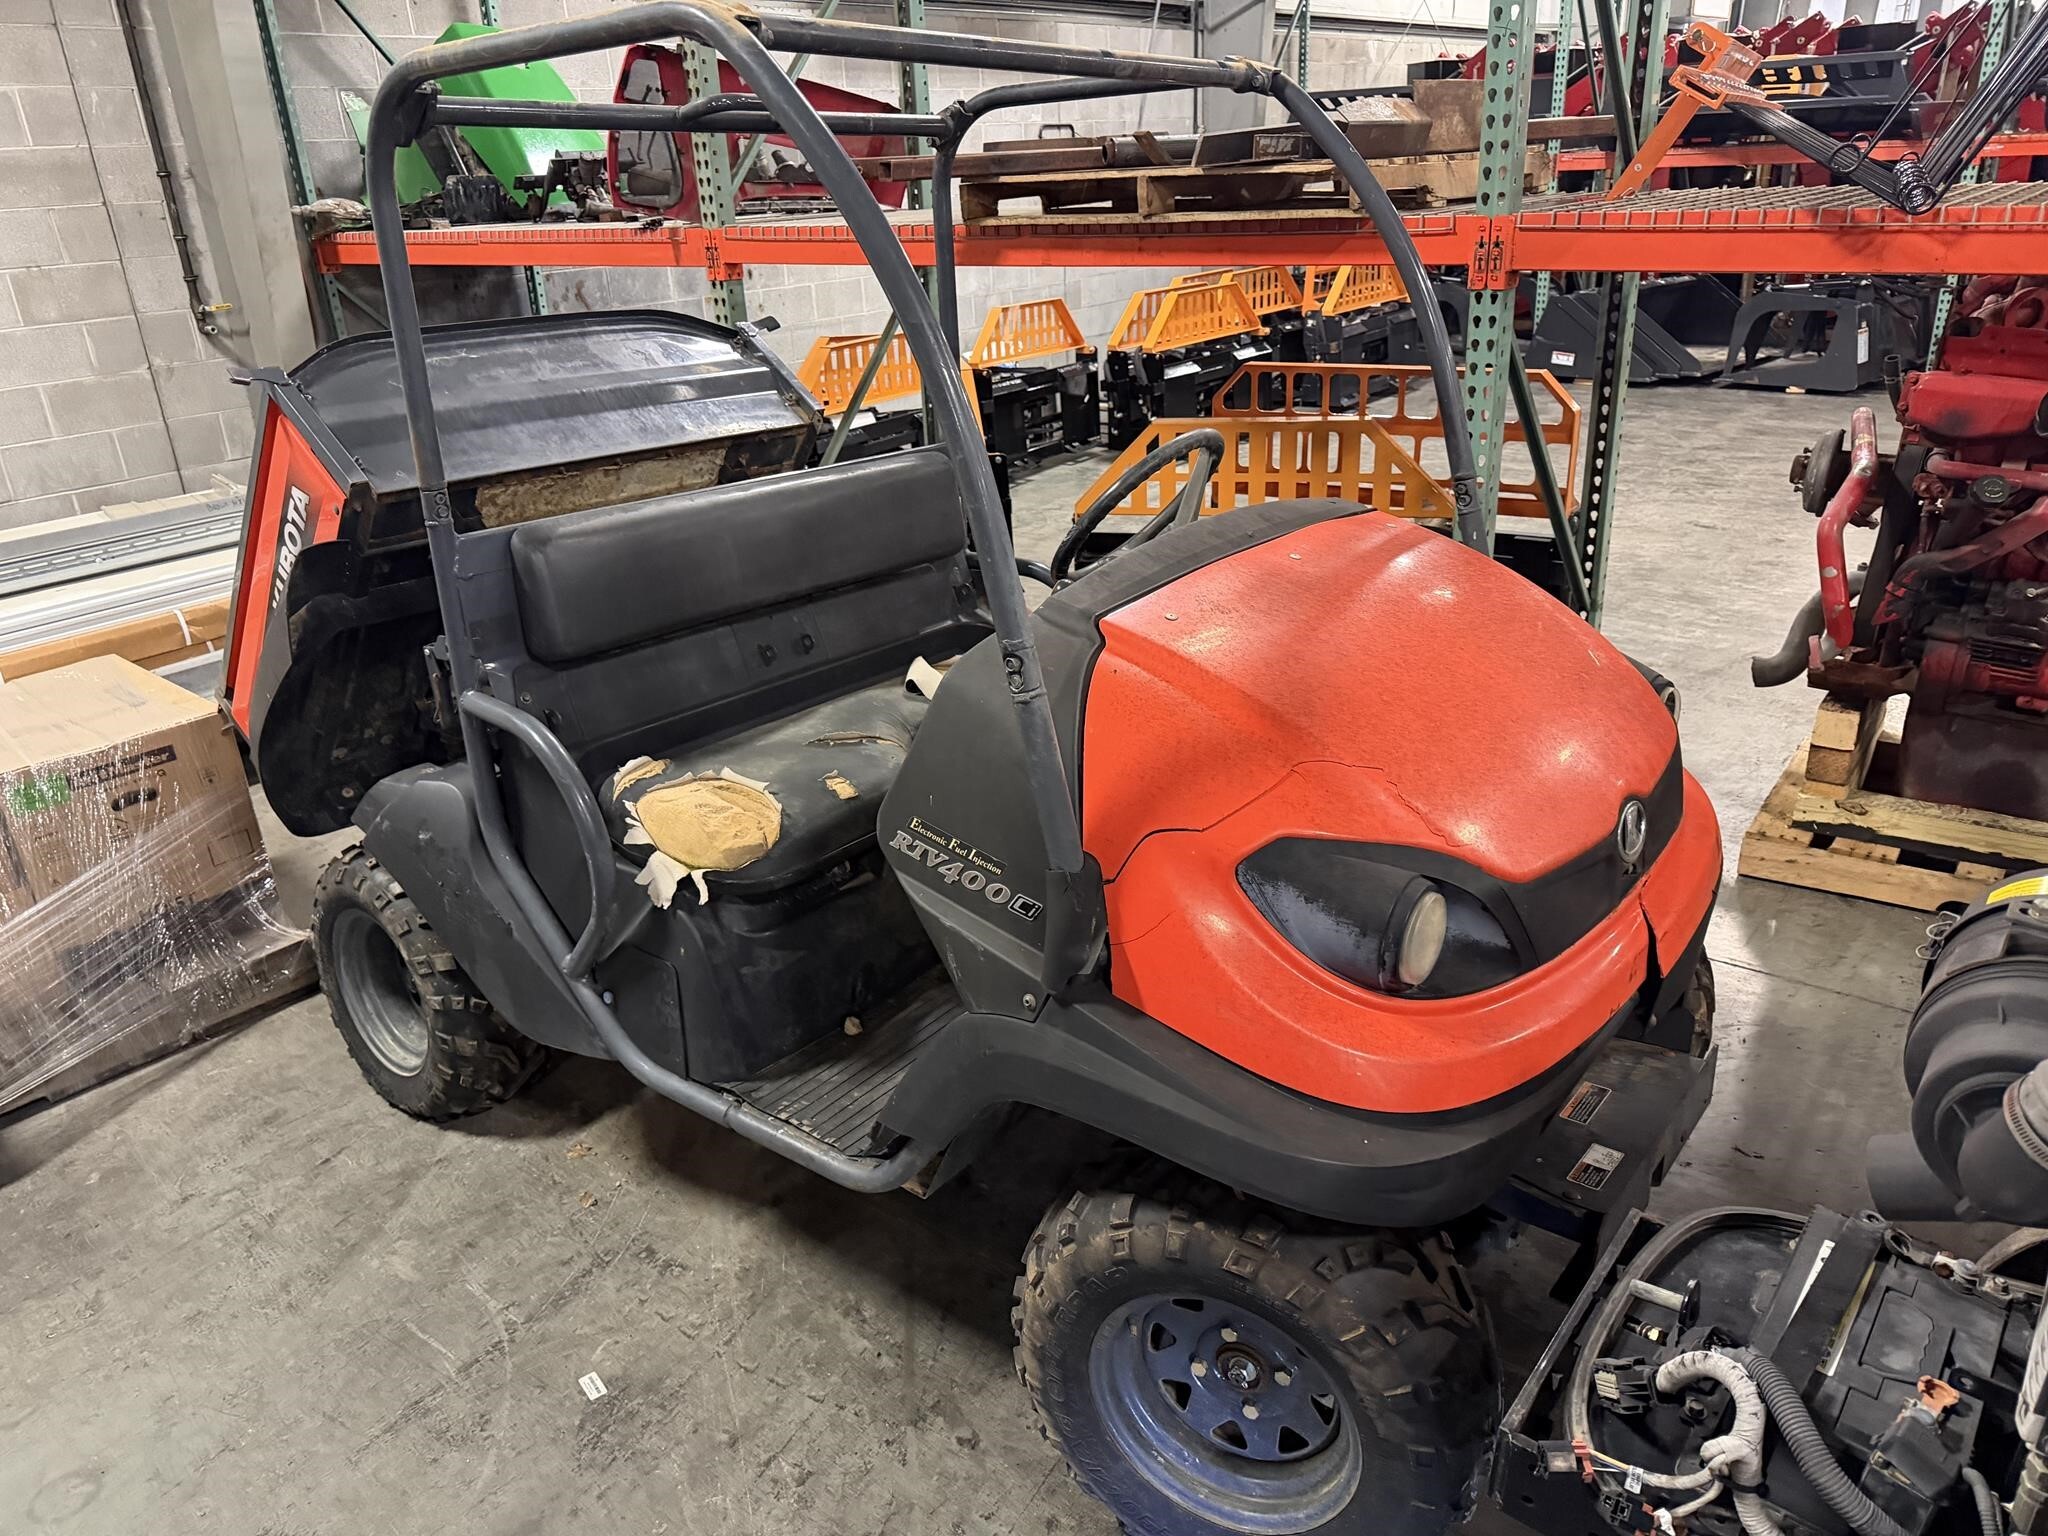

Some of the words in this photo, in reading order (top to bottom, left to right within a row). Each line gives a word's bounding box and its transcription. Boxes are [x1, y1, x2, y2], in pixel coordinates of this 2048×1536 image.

[888, 830, 1012, 905] RTV400
[909, 817, 948, 847] Electronic
[948, 838, 968, 857] Fuel
[967, 849, 1002, 876] Injection
